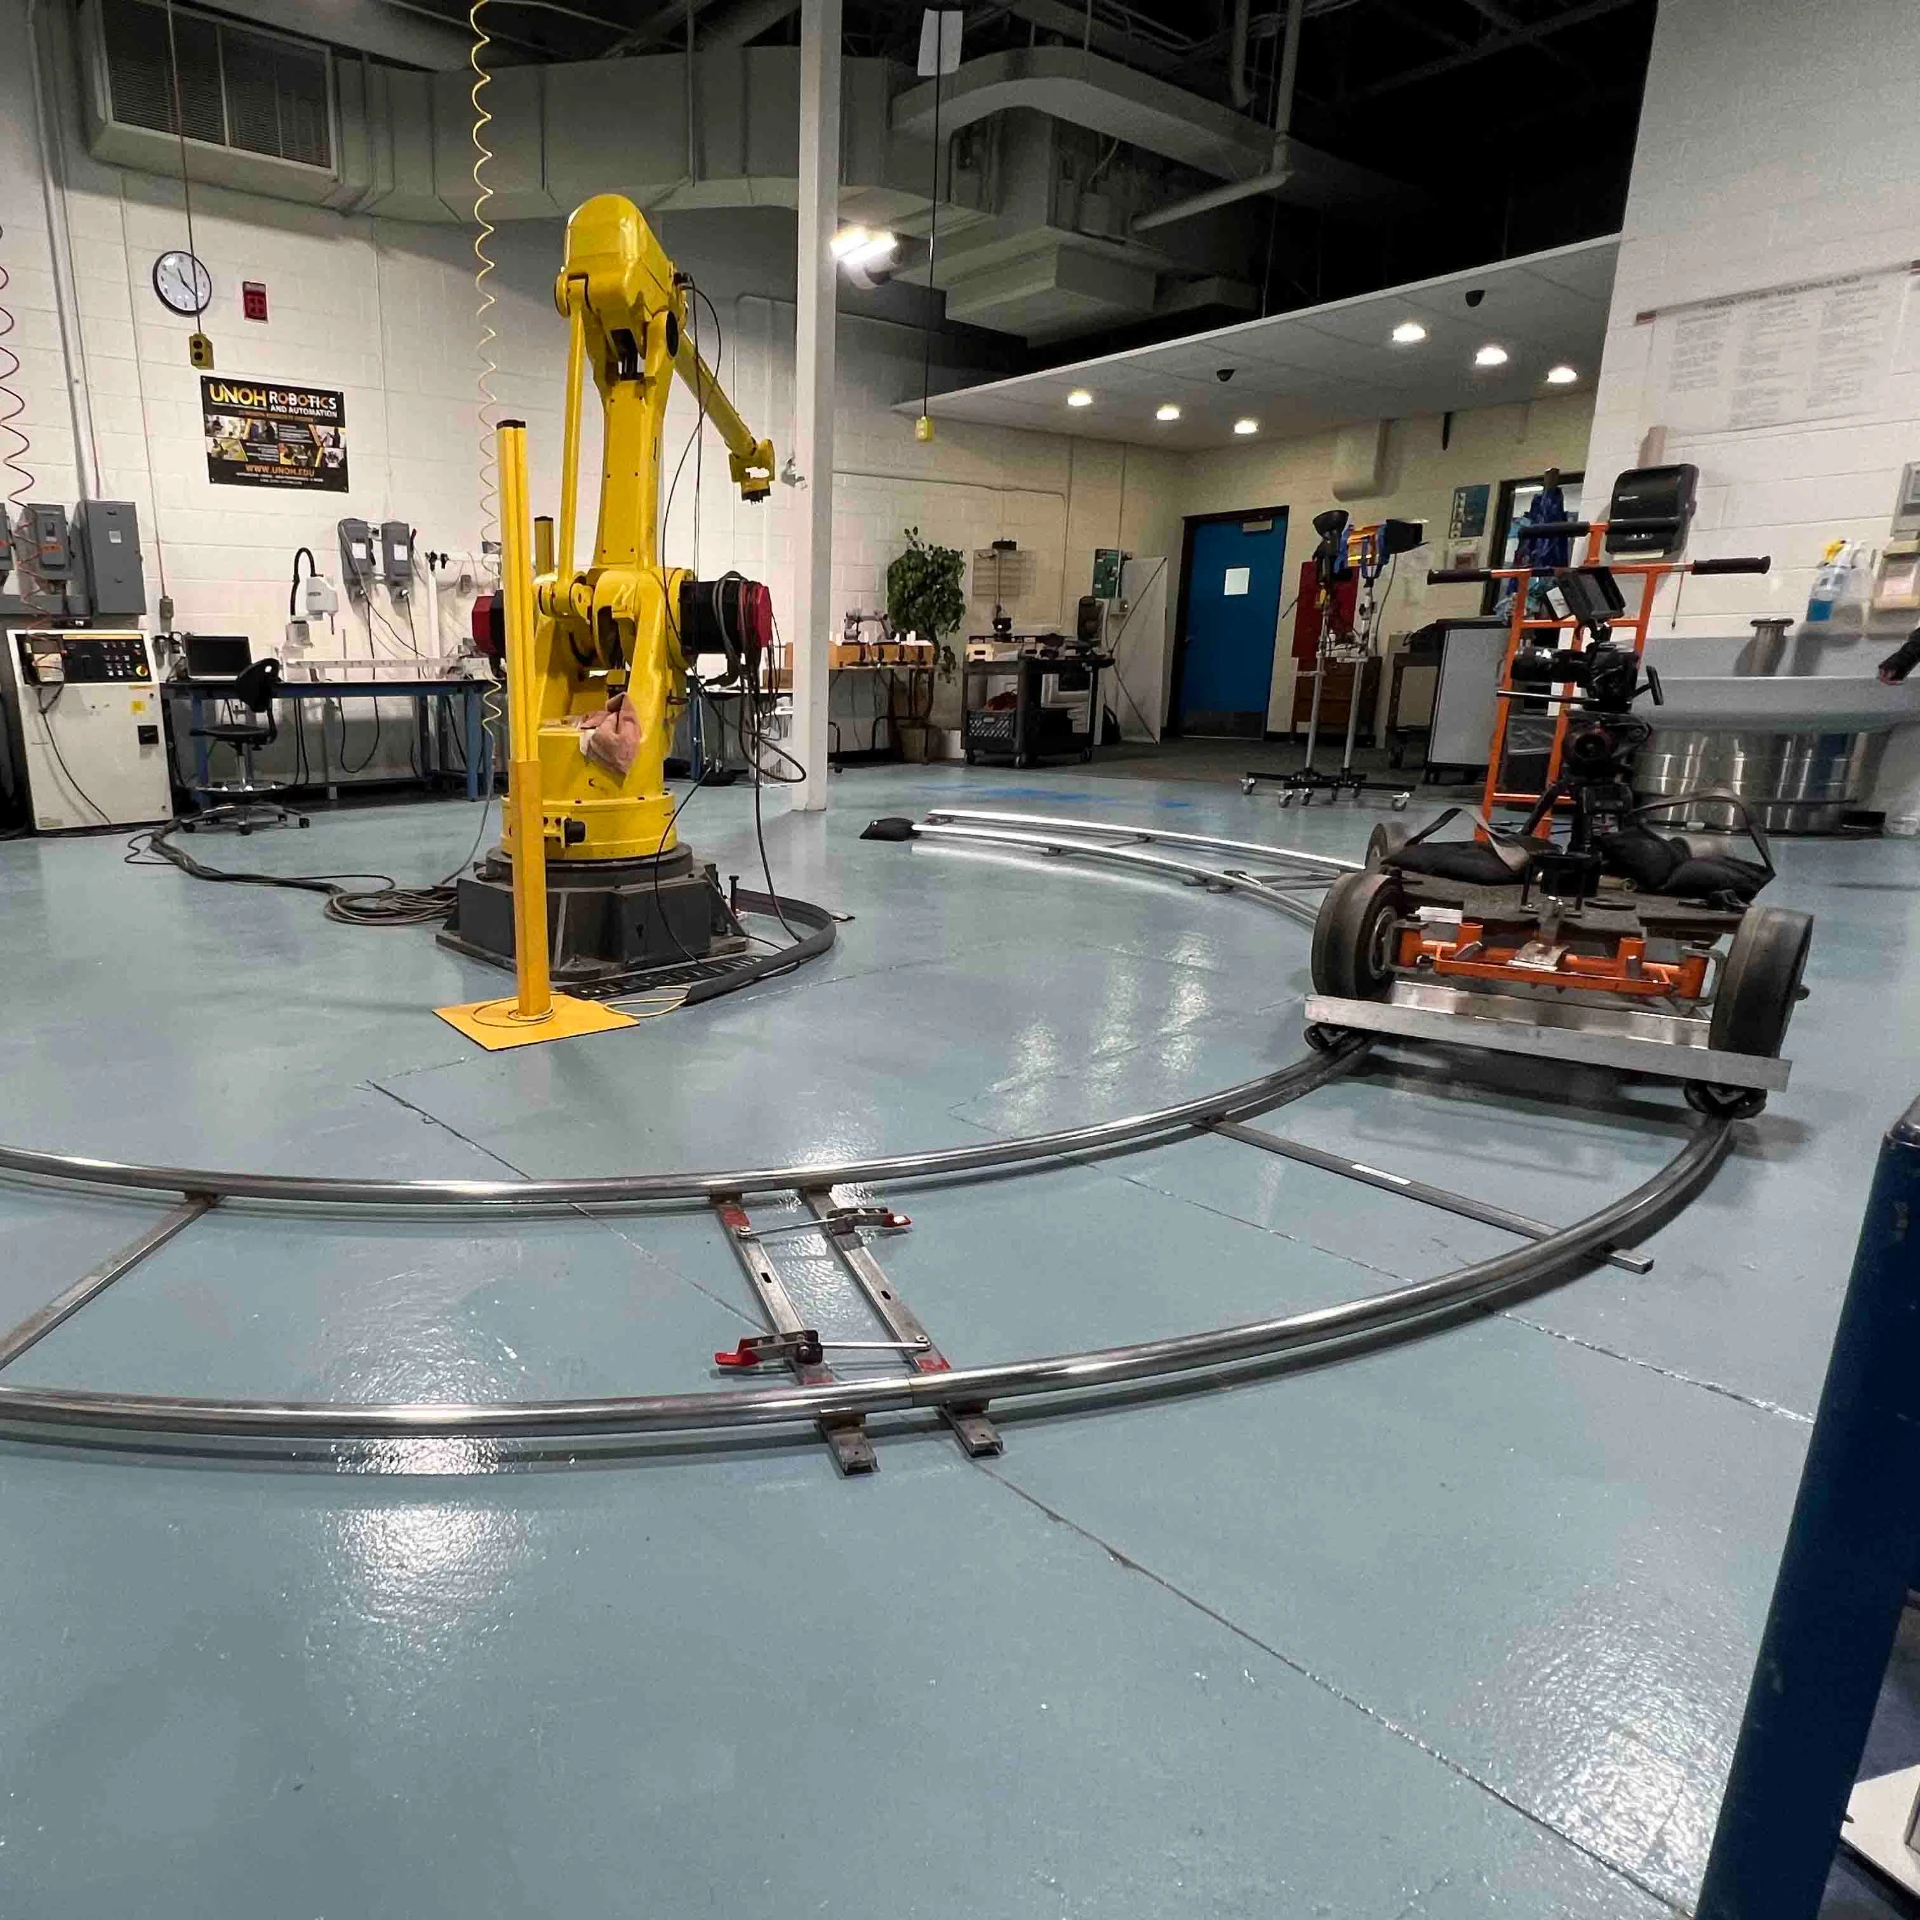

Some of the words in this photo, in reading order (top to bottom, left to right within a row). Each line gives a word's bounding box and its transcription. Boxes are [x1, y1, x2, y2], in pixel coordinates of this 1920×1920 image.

[209, 382, 267, 407] UNOH
[269, 390, 337, 410] ROBOTICS
[270, 405, 288, 413] AND
[288, 407, 338, 418] AUTOMATION
[245, 464, 315, 477] WWW.UNOH.EDU
